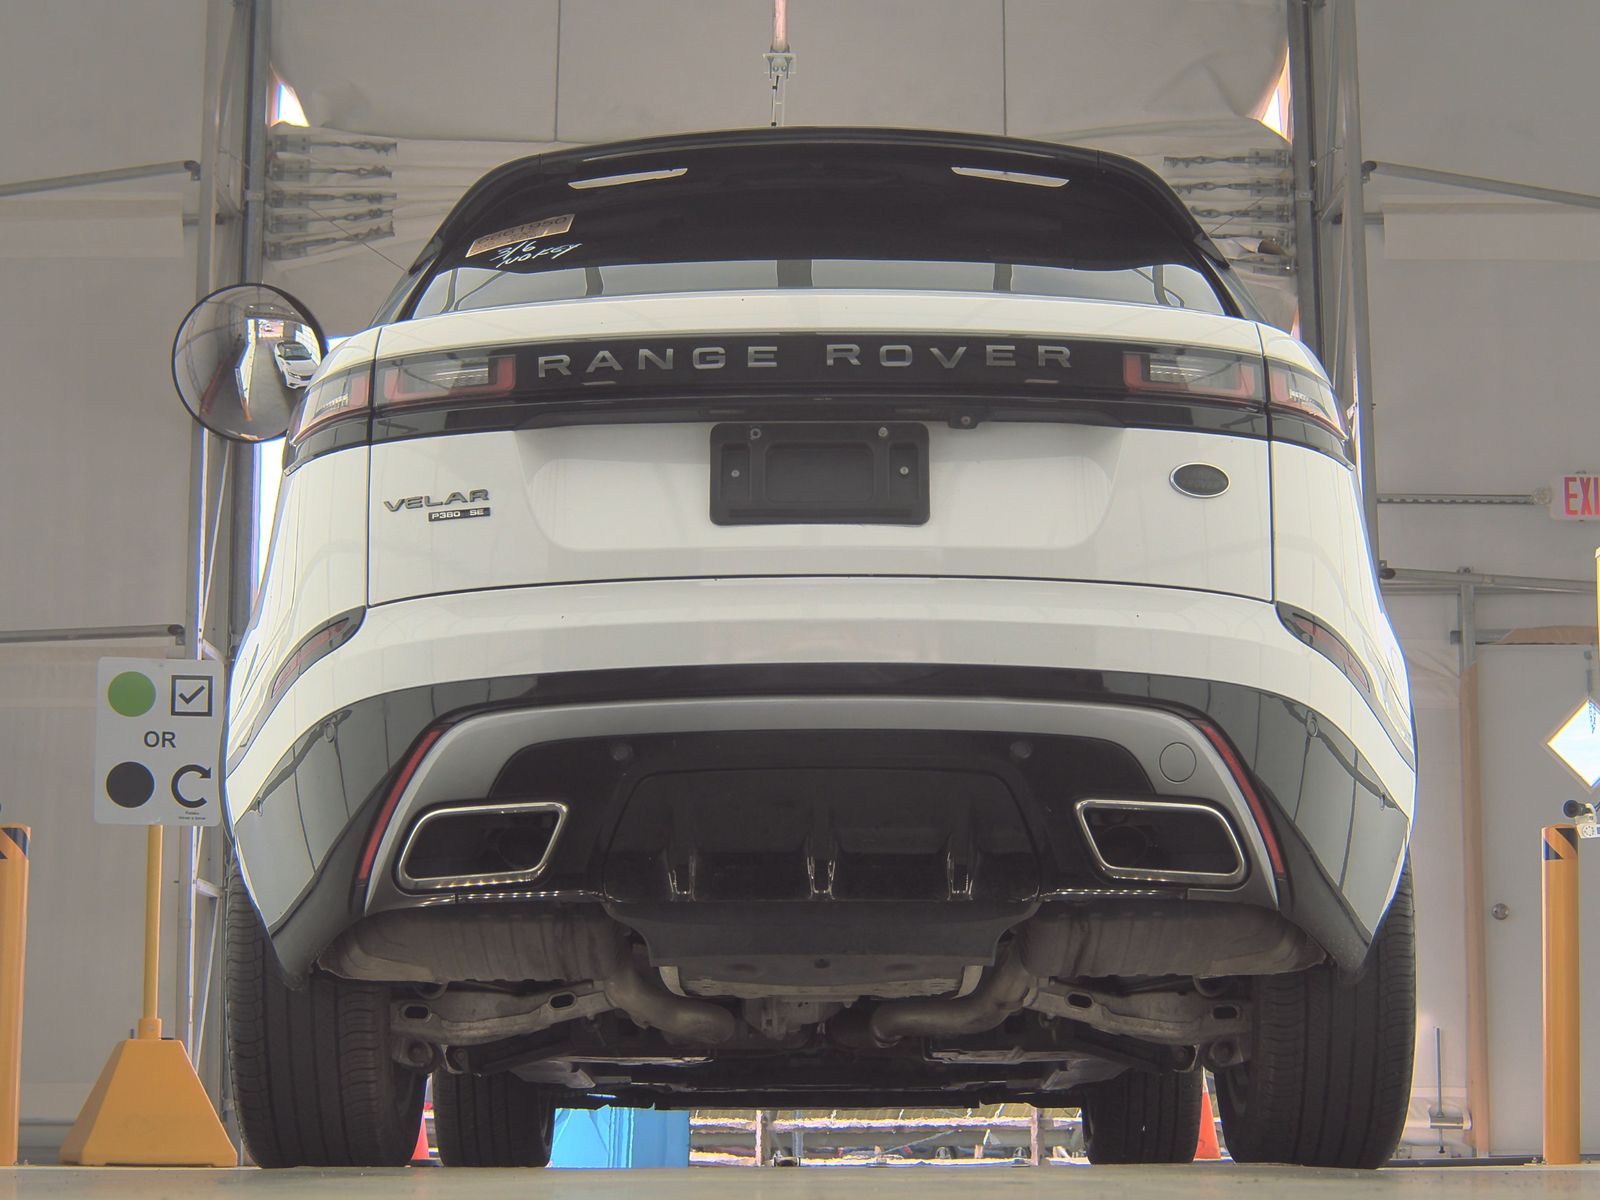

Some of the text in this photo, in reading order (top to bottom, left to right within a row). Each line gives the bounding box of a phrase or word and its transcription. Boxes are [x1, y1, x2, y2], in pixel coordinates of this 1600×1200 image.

[538, 344, 1072, 377] RANGE ROVER
[384, 489, 489, 512] VELAR
[432, 511, 461, 520] P380
[144, 731, 176, 748] OR
